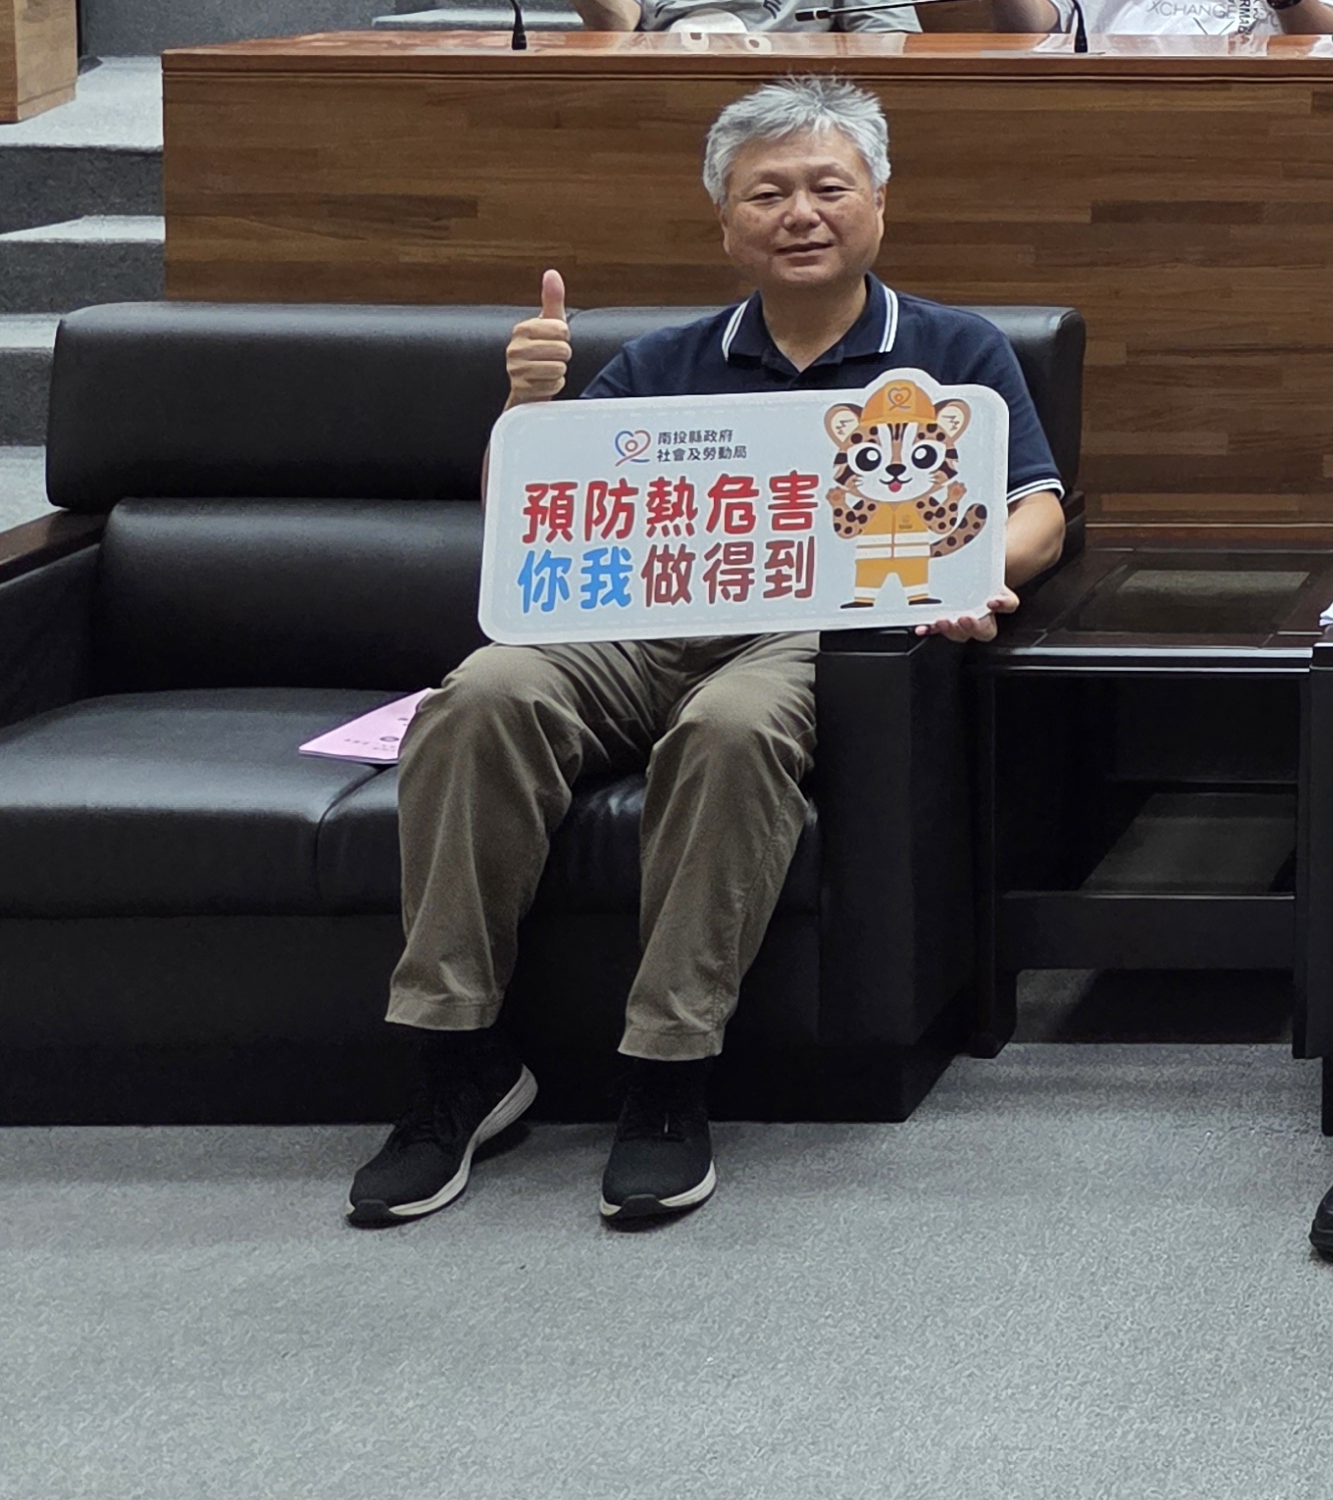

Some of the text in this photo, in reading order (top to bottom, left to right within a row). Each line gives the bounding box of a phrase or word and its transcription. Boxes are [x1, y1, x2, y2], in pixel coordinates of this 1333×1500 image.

[656, 445, 748, 463] 社會及勞動局
[657, 429, 733, 445] 南投縣政府
[521, 470, 821, 544] 預防熱危害
[516, 535, 816, 614] 你我做得到
